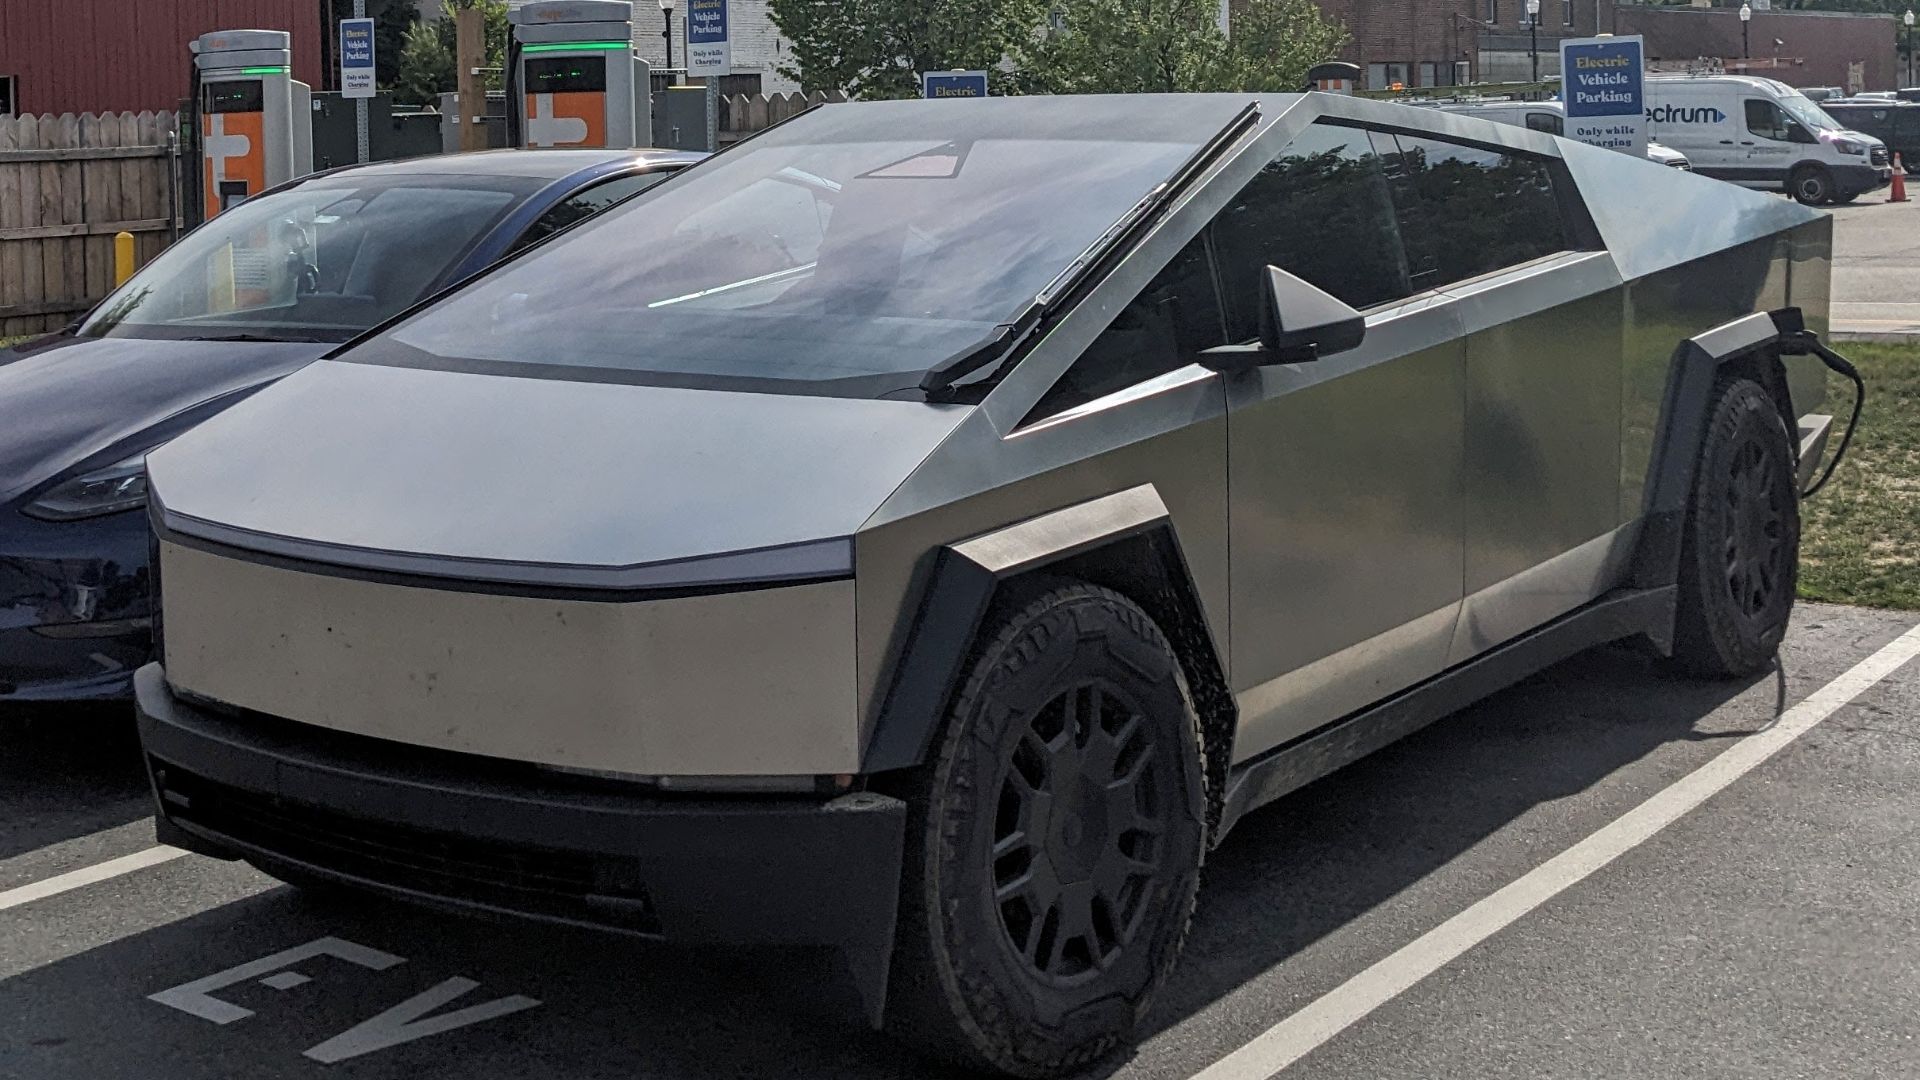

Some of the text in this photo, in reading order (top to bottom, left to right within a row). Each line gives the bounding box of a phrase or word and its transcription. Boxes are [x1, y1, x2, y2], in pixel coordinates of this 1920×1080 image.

[695, 12, 720, 21] Vehicle
[693, 23, 722, 34] Parking
[1576, 55, 1630, 69] Electric
[1578, 72, 1629, 86] Vehicle
[935, 86, 977, 97] Electric
[1576, 90, 1632, 104] Parking
[1577, 126, 1635, 137] Only while
[146, 935, 543, 1064] EV
